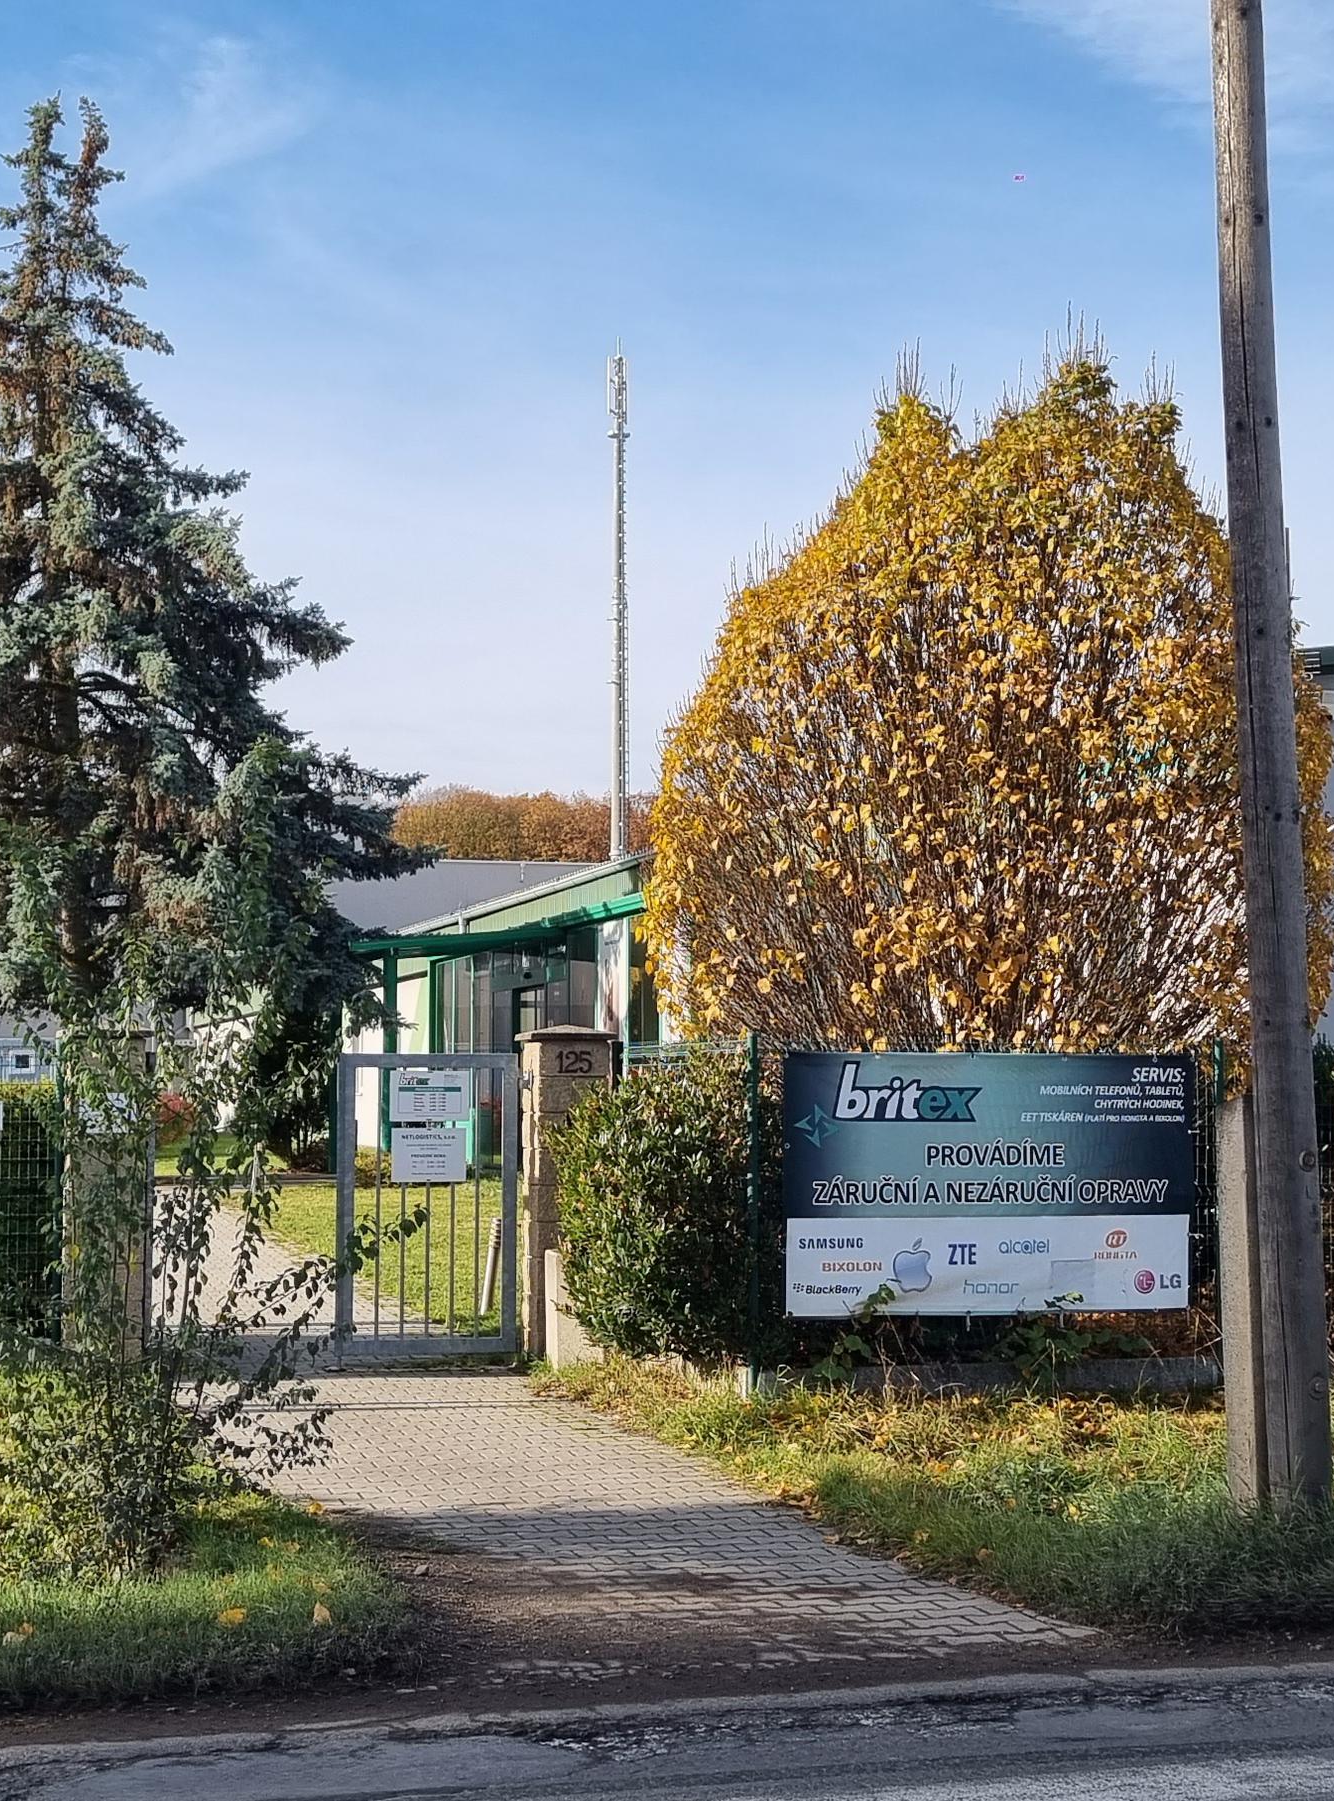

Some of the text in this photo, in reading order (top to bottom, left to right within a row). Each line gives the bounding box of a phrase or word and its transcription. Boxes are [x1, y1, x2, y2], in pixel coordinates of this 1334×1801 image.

[556, 1050, 593, 1074] 125
[1131, 1067, 1186, 1082] SERVIS:
[834, 1062, 979, 1120] britex
[1039, 1083, 1185, 1097] MOBILNÍCH TELEFONŮ, TABLETŮ,
[1094, 1097, 1184, 1110] CHYTRÝCH HODINEK,
[1021, 1112, 1039, 1122] EET
[1039, 1110, 1084, 1122] TISKÁREN
[925, 1138, 1065, 1168] PROVÁDÍME
[812, 1175, 1169, 1206] ZÁRUČNÍ A NEZÁRUČNÍ OPRAVY
[798, 1237, 864, 1250] SAMSUNG
[998, 1239, 1050, 1255] alcatel
[948, 1243, 977, 1266] ZTE
[821, 1261, 883, 1273] BIXOLON
[963, 1279, 1020, 1295] honor
[1159, 1274, 1182, 1290] LG
[805, 1284, 863, 1297] BlackBerry
